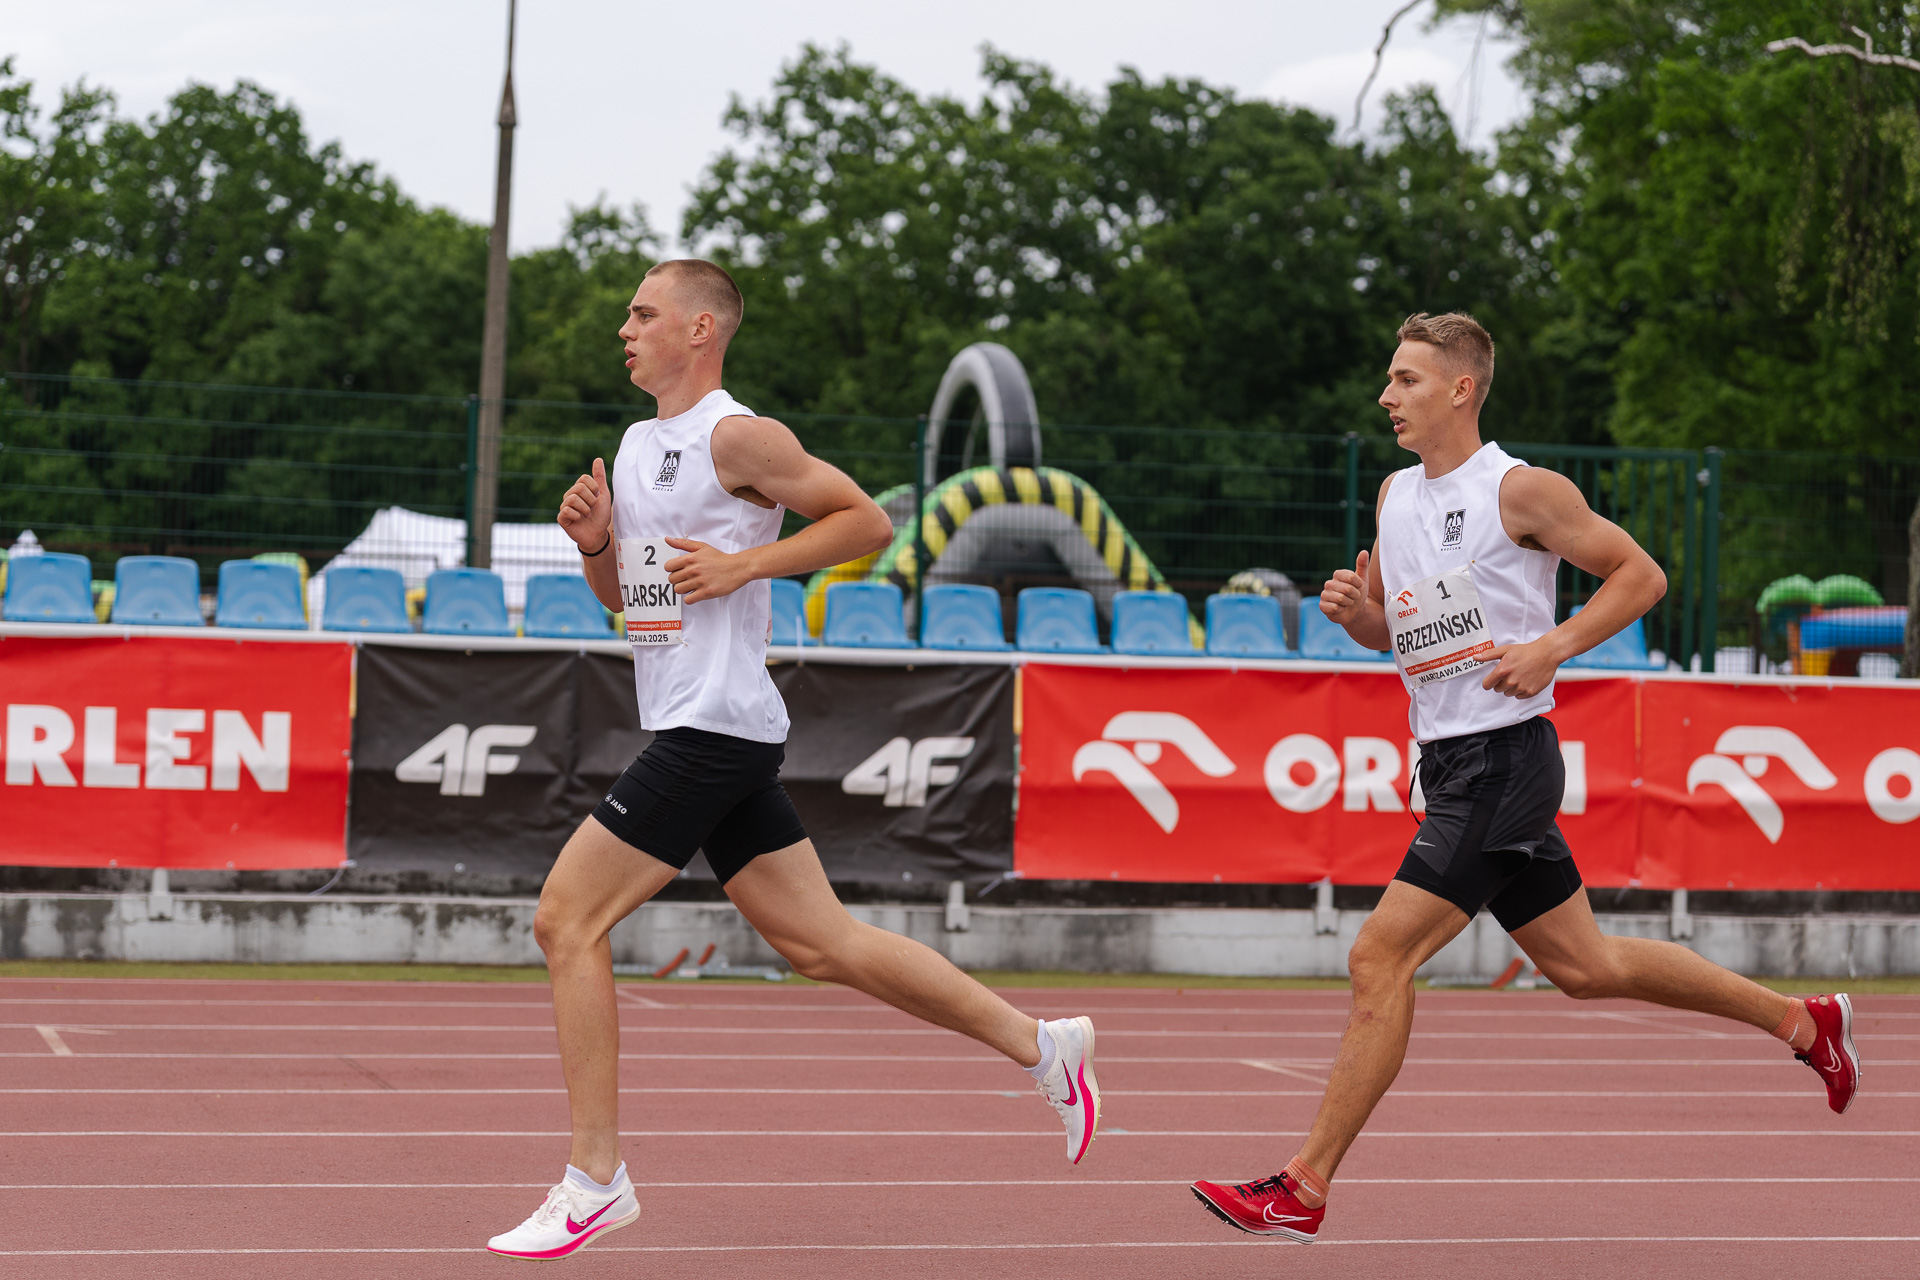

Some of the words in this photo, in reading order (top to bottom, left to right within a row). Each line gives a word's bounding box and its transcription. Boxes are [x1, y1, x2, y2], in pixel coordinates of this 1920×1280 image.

[656, 474, 675, 483] AWF
[660, 466, 677, 475] AZS
[1446, 524, 1462, 536] AZS
[644, 545, 657, 566] 2
[1436, 580, 1452, 600] 1
[1397, 606, 1418, 619] ORLEN
[648, 634, 669, 642] 2025
[1397, 608, 1483, 654] BRZEZIŃSKI
[0, 703, 291, 792] RLEN
[395, 723, 537, 796] 4F
[841, 736, 975, 807] 4F
[609, 799, 628, 815] JAKO
